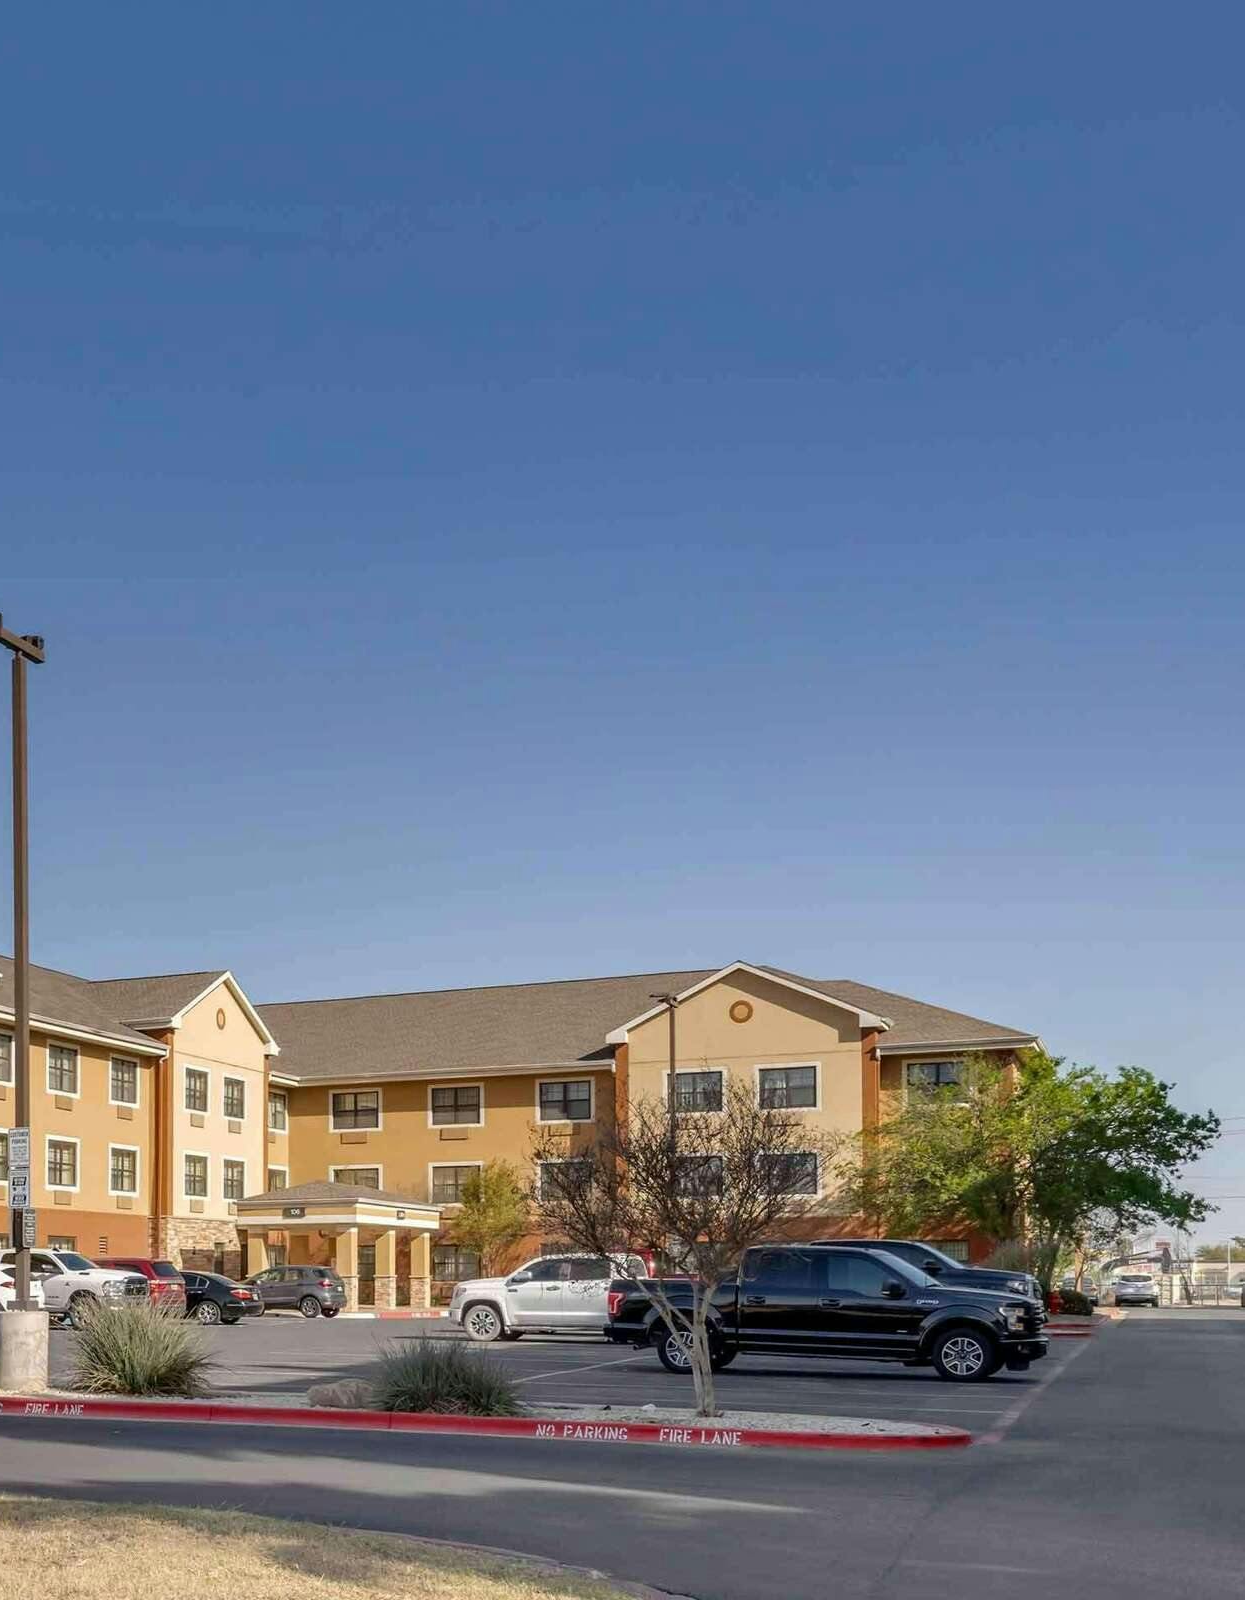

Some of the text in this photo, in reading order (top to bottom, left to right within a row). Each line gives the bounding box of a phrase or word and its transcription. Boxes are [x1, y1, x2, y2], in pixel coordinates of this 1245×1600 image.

[24, 1402, 49, 1415] FIRE
[54, 1404, 84, 1416] LANE
[535, 1423, 743, 1446] NO PARKING FIRE LANE
